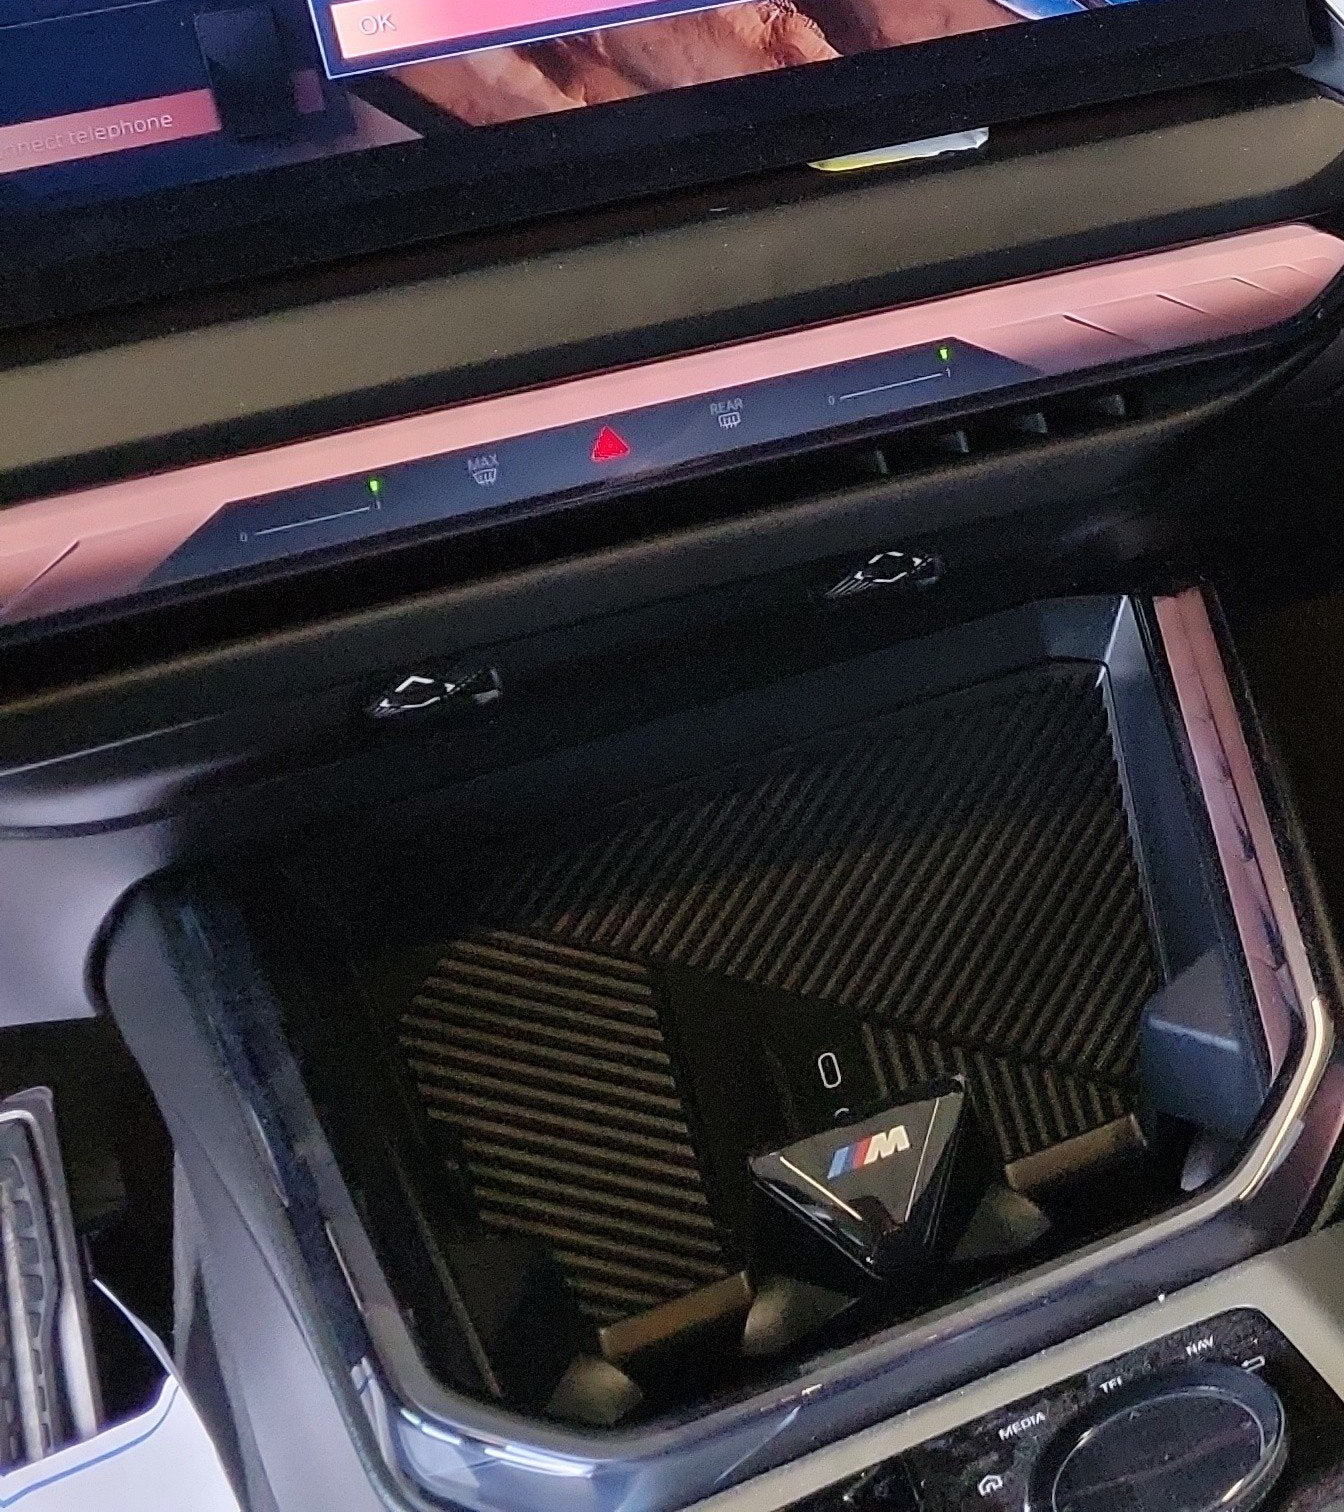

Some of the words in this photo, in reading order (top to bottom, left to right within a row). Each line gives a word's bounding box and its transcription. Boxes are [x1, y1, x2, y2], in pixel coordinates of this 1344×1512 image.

[358, 11, 397, 36] OK
[68, 113, 174, 146] telephone
[709, 397, 744, 416] REAR
[467, 453, 501, 471] MAX
[1185, 1334, 1214, 1357] NAV
[997, 1410, 1047, 1443] MEDIA
